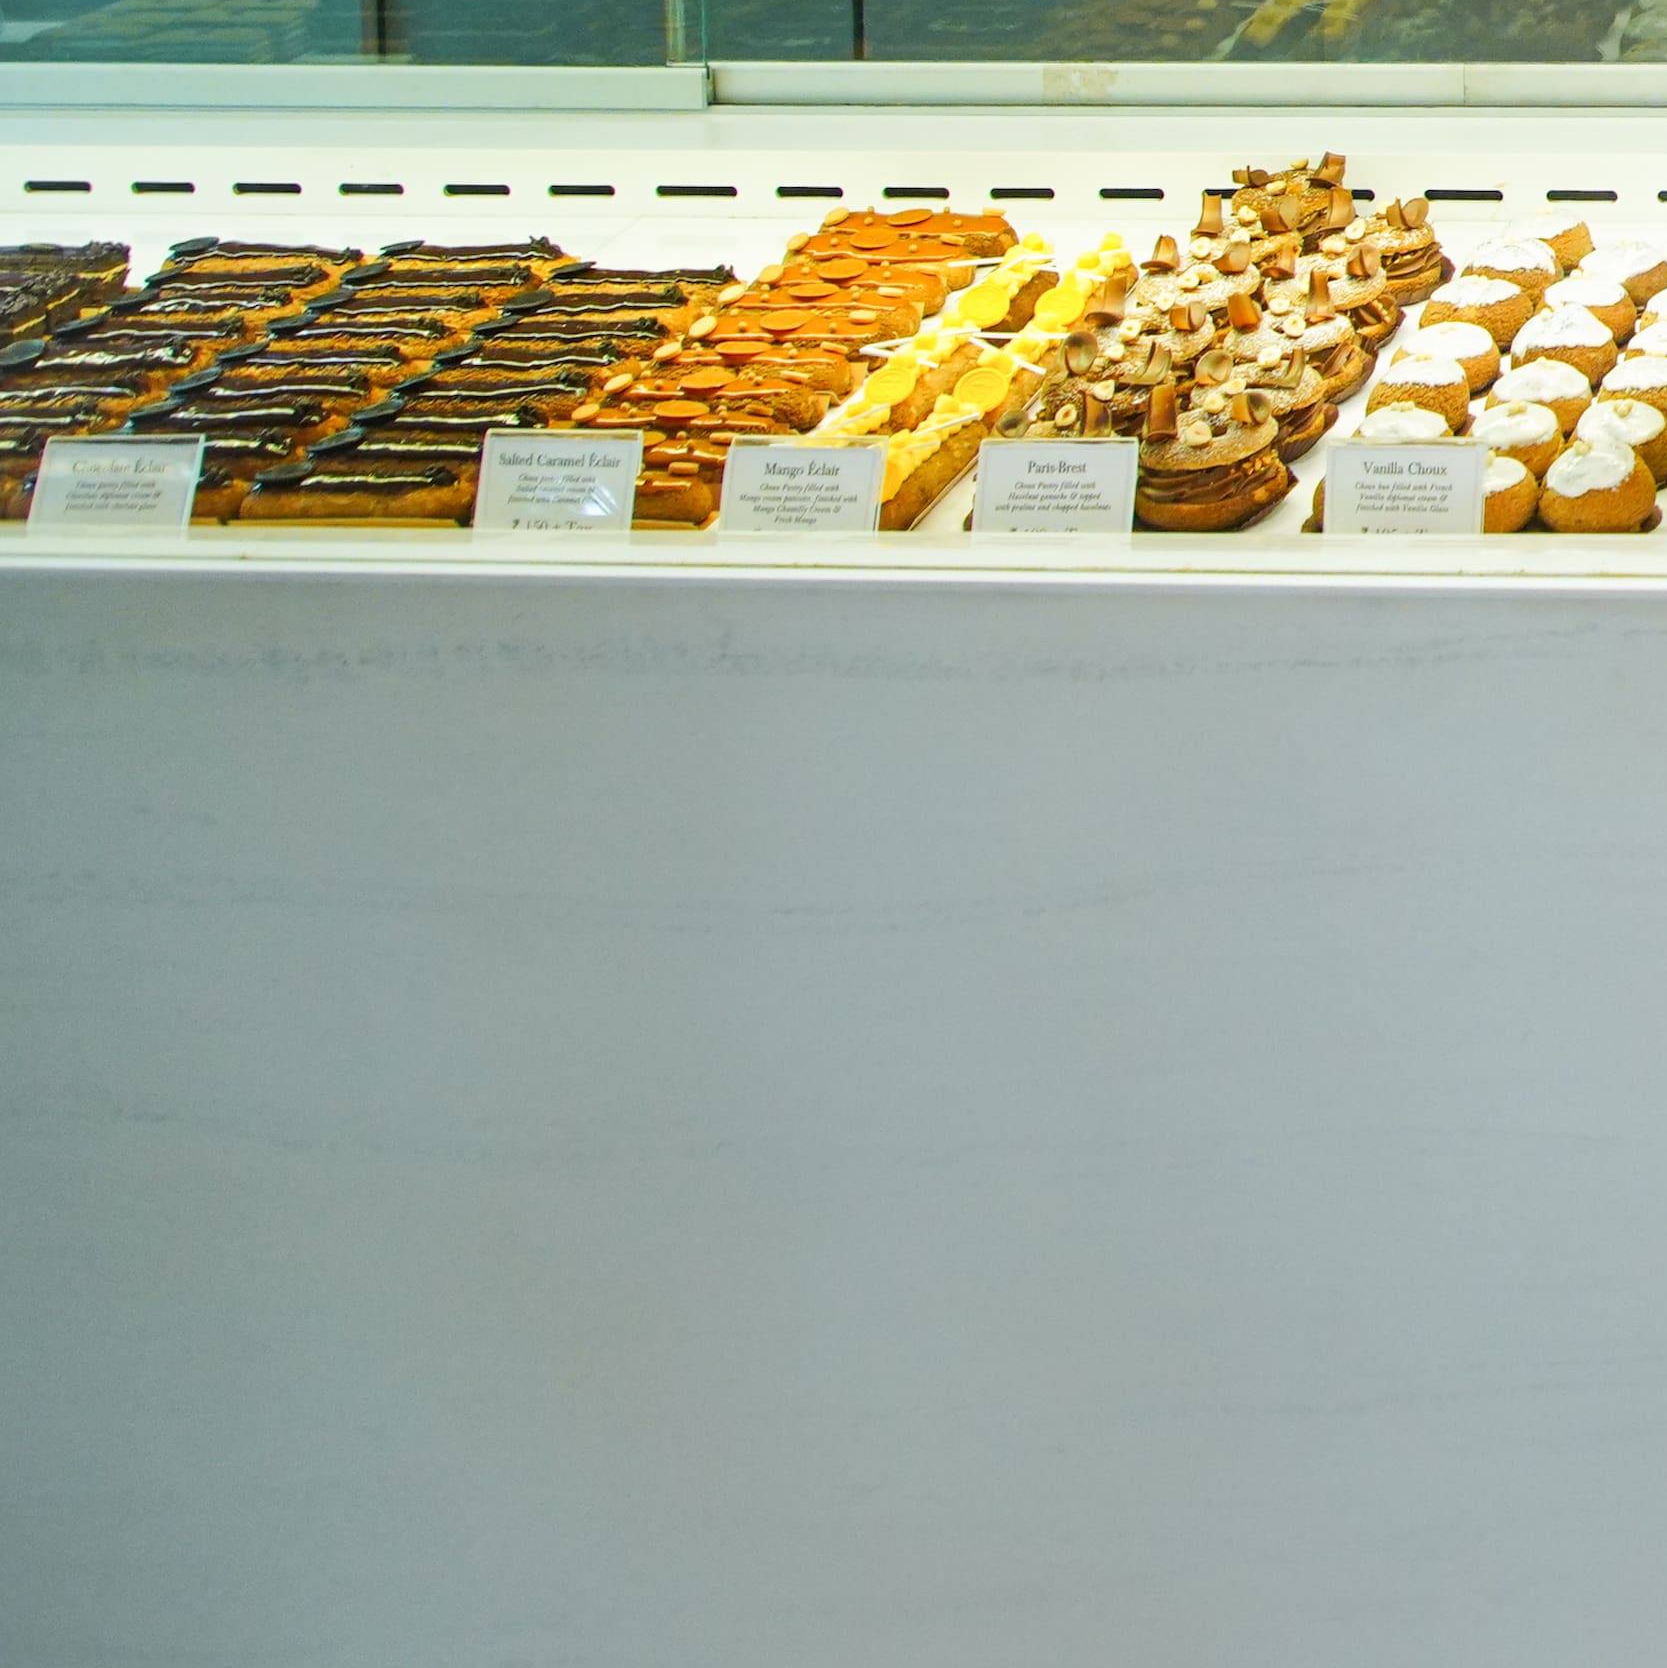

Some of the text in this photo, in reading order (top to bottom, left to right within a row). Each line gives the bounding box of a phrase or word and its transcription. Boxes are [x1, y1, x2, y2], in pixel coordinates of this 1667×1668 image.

[499, 451, 621, 469] Salted Caramel Éclair
[764, 460, 840, 480] Mango Éclair
[1363, 461, 1448, 475] Vanilla Choux
[825, 483, 839, 492] with
[1413, 483, 1427, 491] with
[1385, 504, 1400, 512] with
